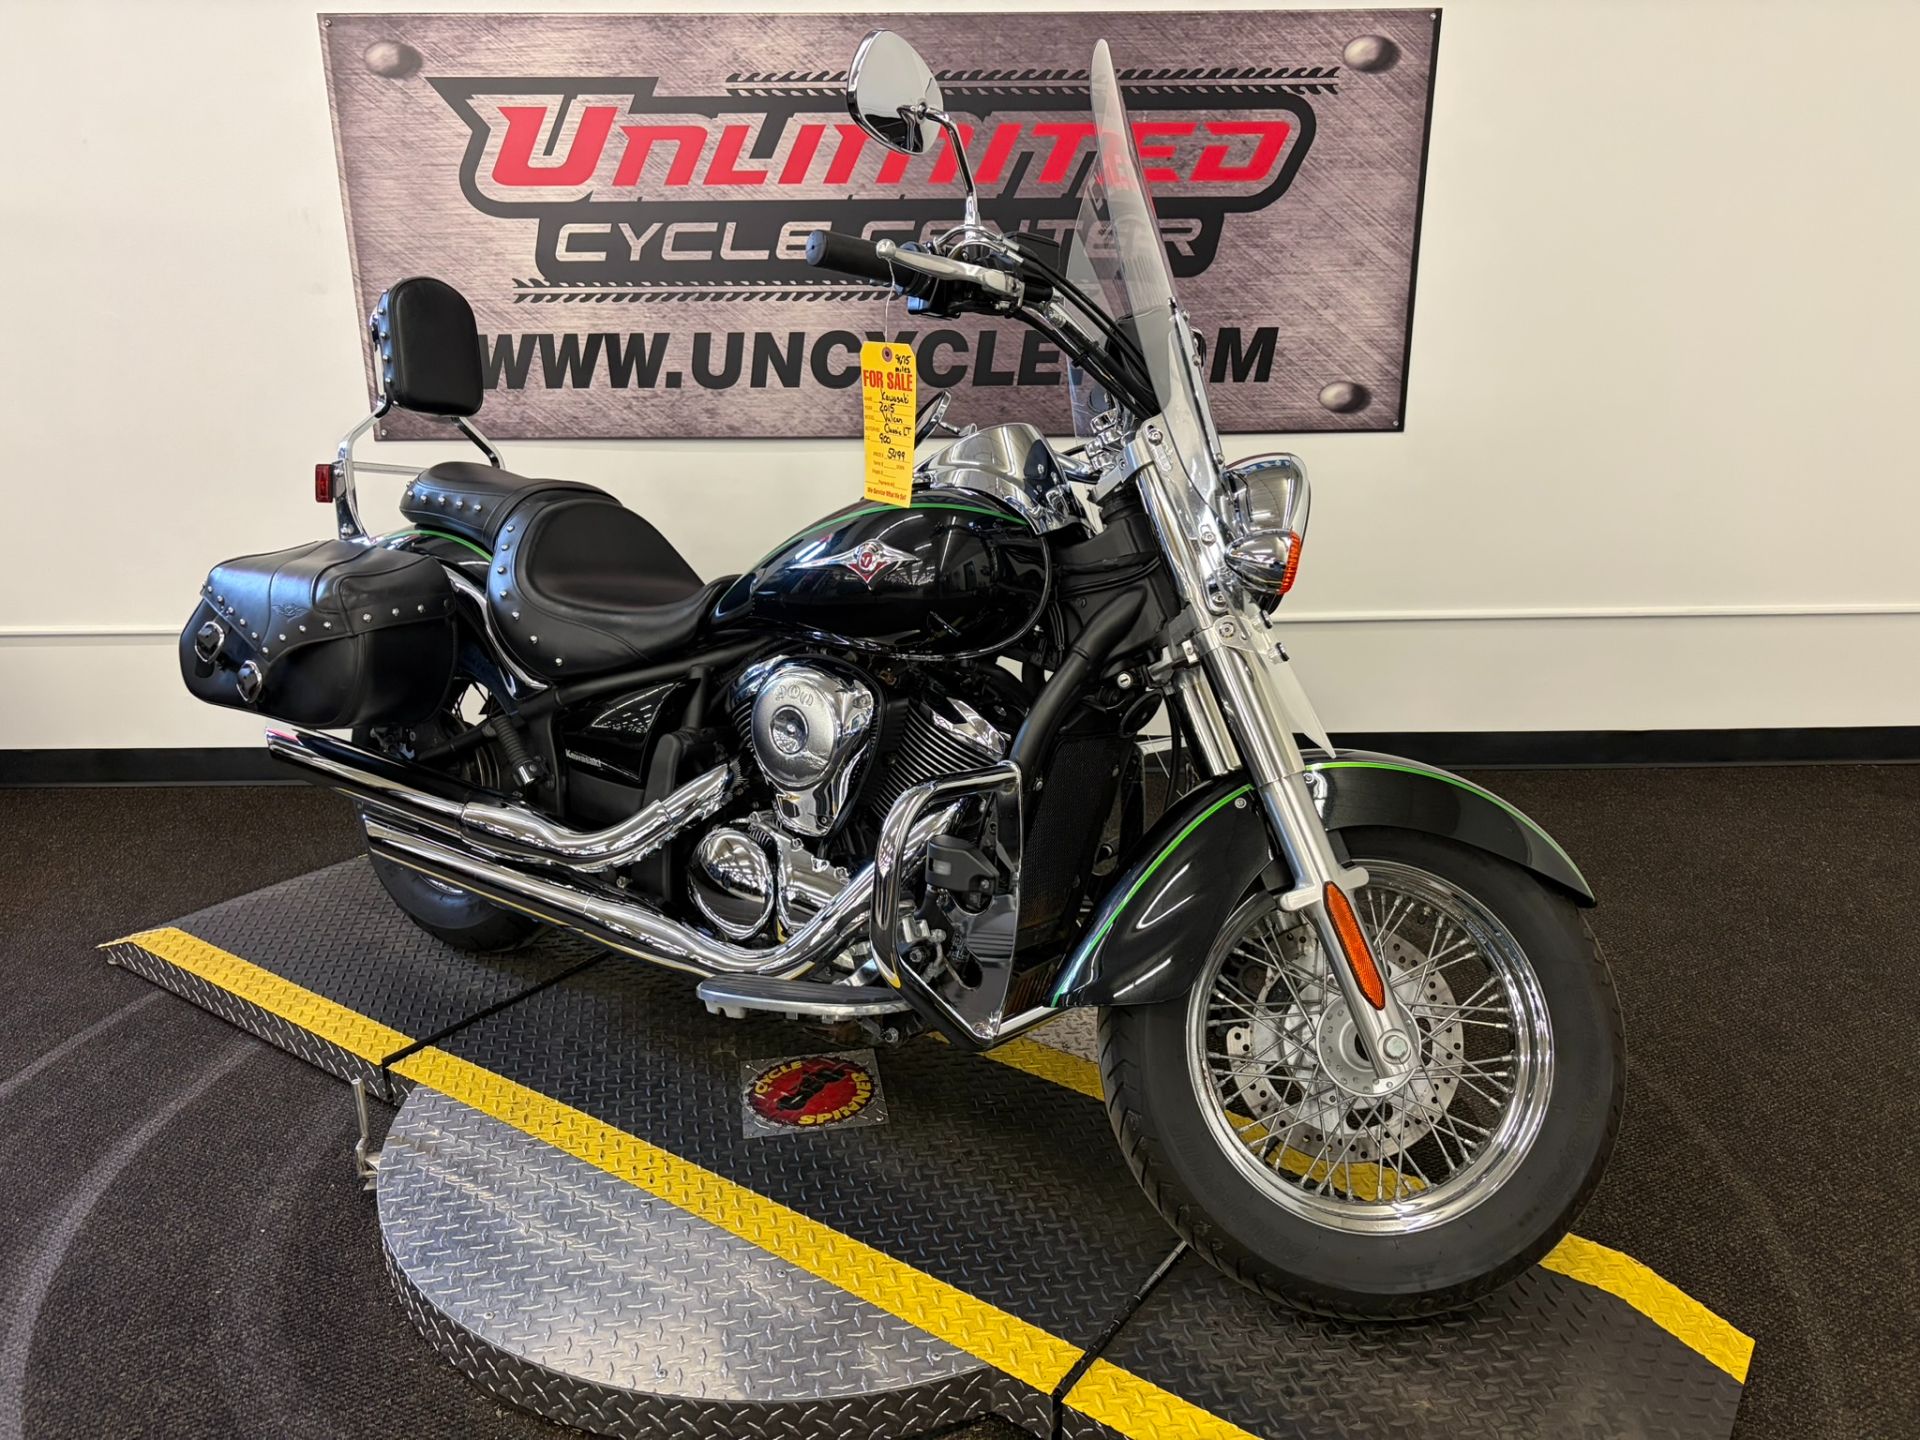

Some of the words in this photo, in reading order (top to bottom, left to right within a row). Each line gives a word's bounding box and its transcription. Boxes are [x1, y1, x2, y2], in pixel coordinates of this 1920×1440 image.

[555, 221, 833, 262] CYCLE
[477, 326, 1280, 390] WWW.UNCCLE.M
[863, 369, 884, 389] FOR
[887, 371, 913, 392] SALE
[879, 401, 895, 413] 2015
[879, 432, 892, 444] 900
[755, 1060, 803, 1095] CYCLE
[798, 1071, 873, 1125] SPINNER
